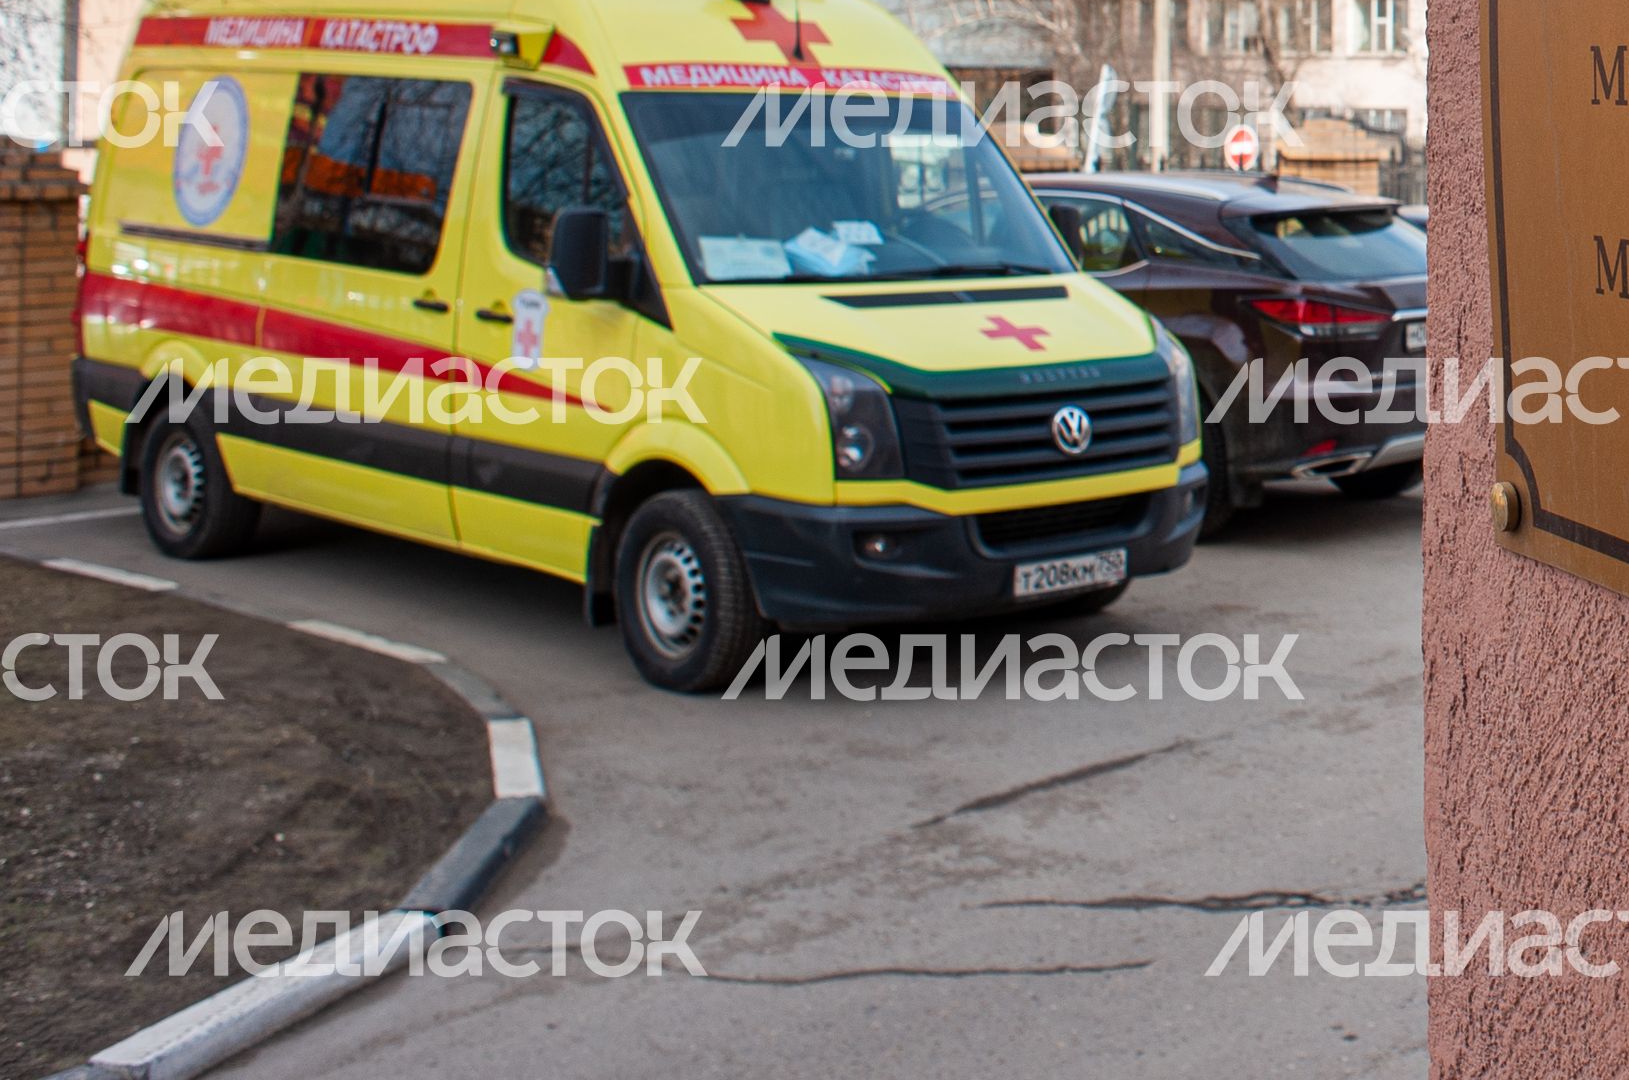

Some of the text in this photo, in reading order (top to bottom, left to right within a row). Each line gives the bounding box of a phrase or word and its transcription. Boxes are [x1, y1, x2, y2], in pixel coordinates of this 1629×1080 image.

[205, 17, 439, 54] МЕДИЦИНА КАТАСТРОФ
[639, 63, 808, 88] МЕДИЦИНА
